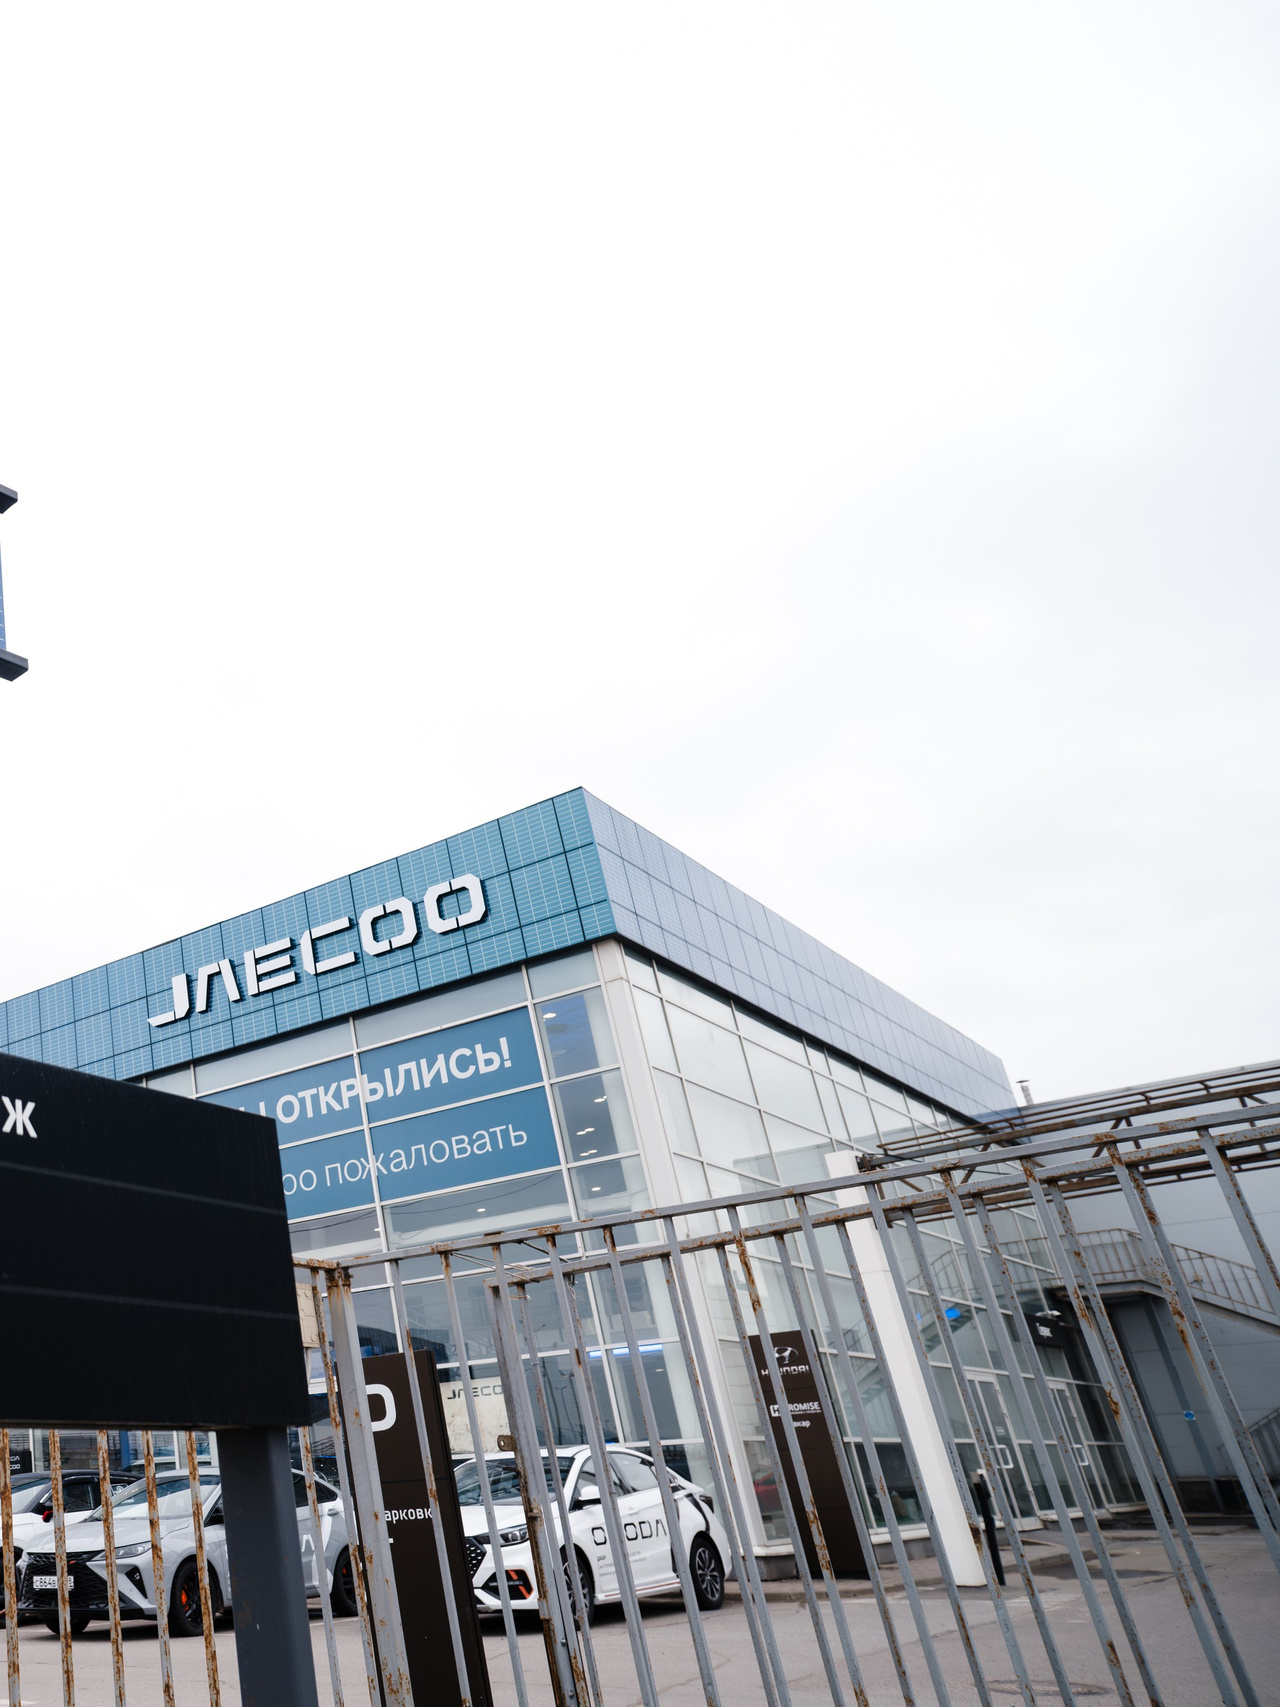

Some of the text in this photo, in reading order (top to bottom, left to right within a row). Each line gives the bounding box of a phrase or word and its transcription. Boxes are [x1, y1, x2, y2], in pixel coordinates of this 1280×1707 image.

[147, 873, 487, 1027] JAECOO
[276, 1036, 512, 1124] ОТКРЫЛИСЬ!
[325, 1119, 528, 1187] пожаловать
[385, 1508, 433, 1524] арковк
[591, 1518, 667, 1546] OODA
